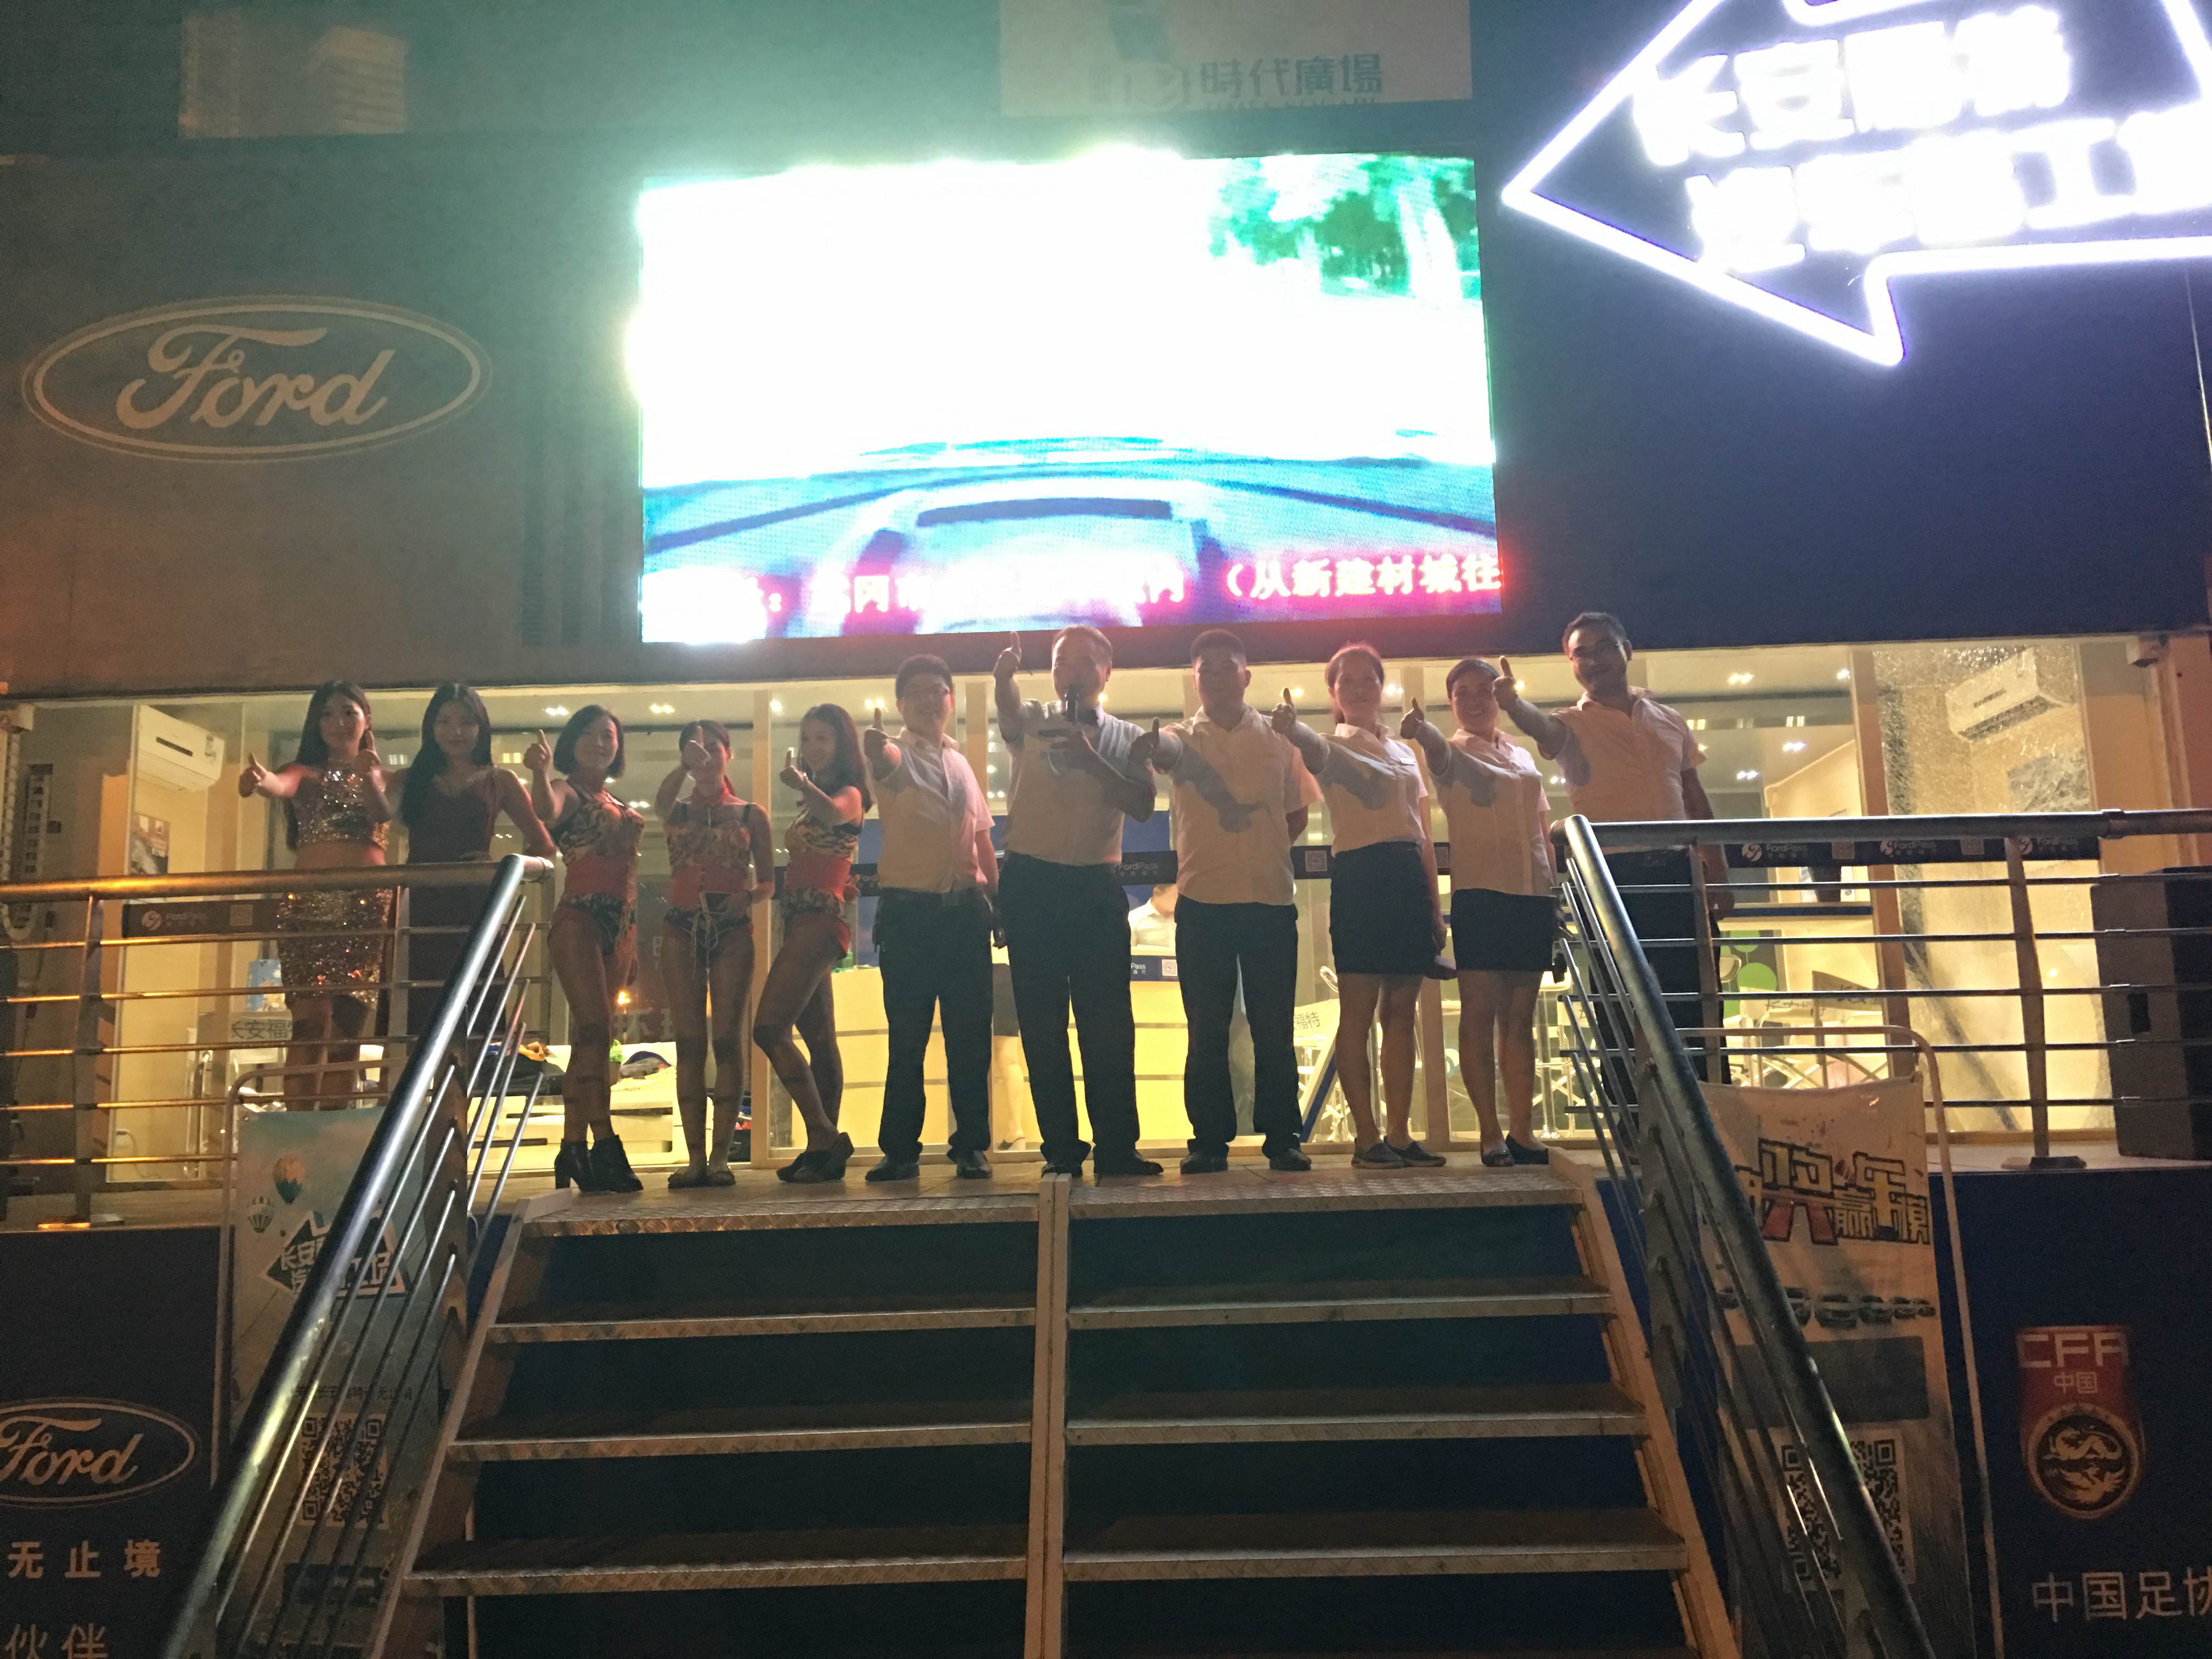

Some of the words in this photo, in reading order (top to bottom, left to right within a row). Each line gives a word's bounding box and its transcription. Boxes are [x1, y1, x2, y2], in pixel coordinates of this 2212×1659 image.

[1201, 53, 1383, 99] 時代廣場
[116, 324, 397, 429] Ford
[1118, 861, 1159, 871] FordPass
[231, 1019, 293, 1040] 长安福
[2054, 1372, 2098, 1395] 中国
[0, 1415, 144, 1485] Ford
[8, 1539, 161, 1579] 无止境
